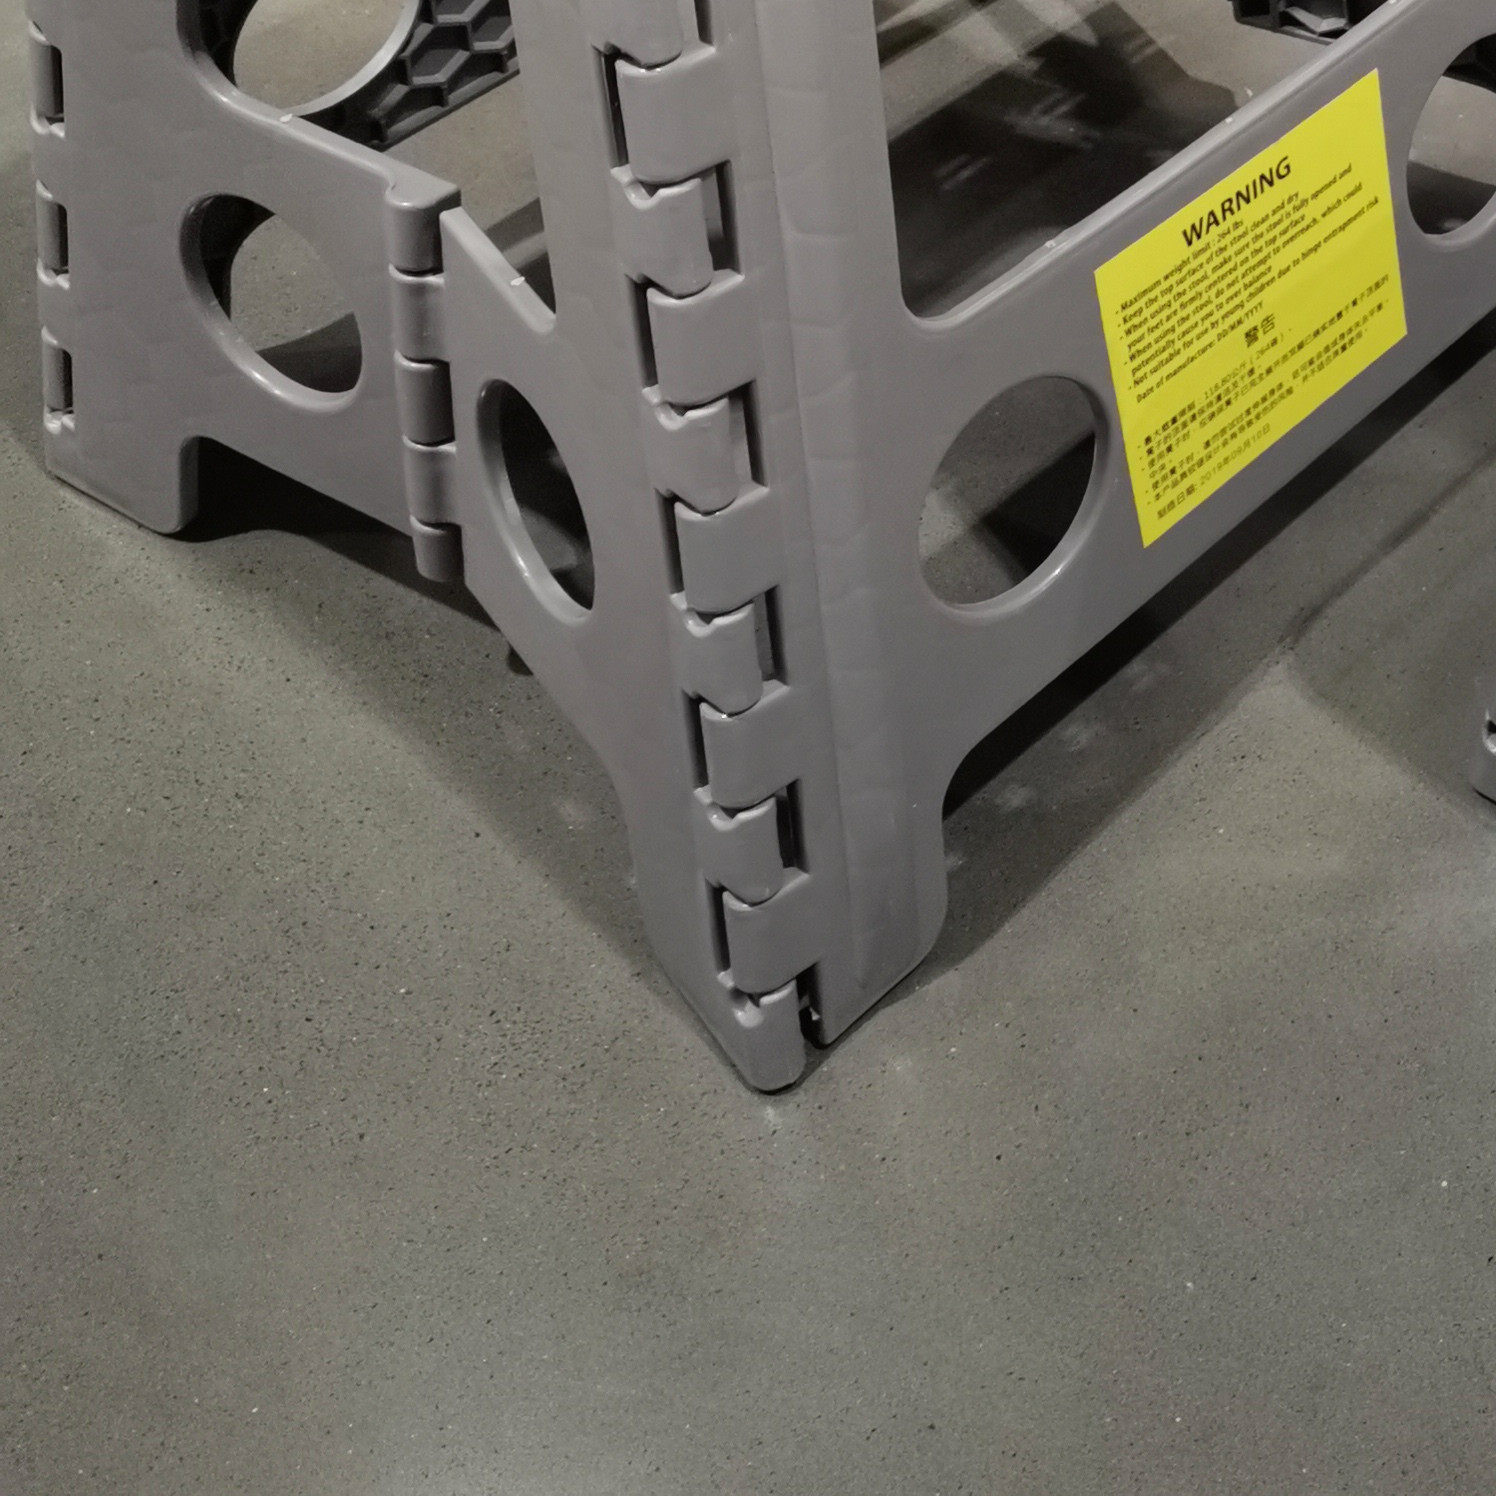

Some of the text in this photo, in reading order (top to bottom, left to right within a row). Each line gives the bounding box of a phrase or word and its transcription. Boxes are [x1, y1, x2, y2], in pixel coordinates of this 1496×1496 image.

[1182, 155, 1291, 248] WARNING
[1230, 226, 1248, 246] stool
[1120, 278, 1161, 313] Maximum
[1163, 255, 1190, 281] weight
[1150, 299, 1171, 320] using
